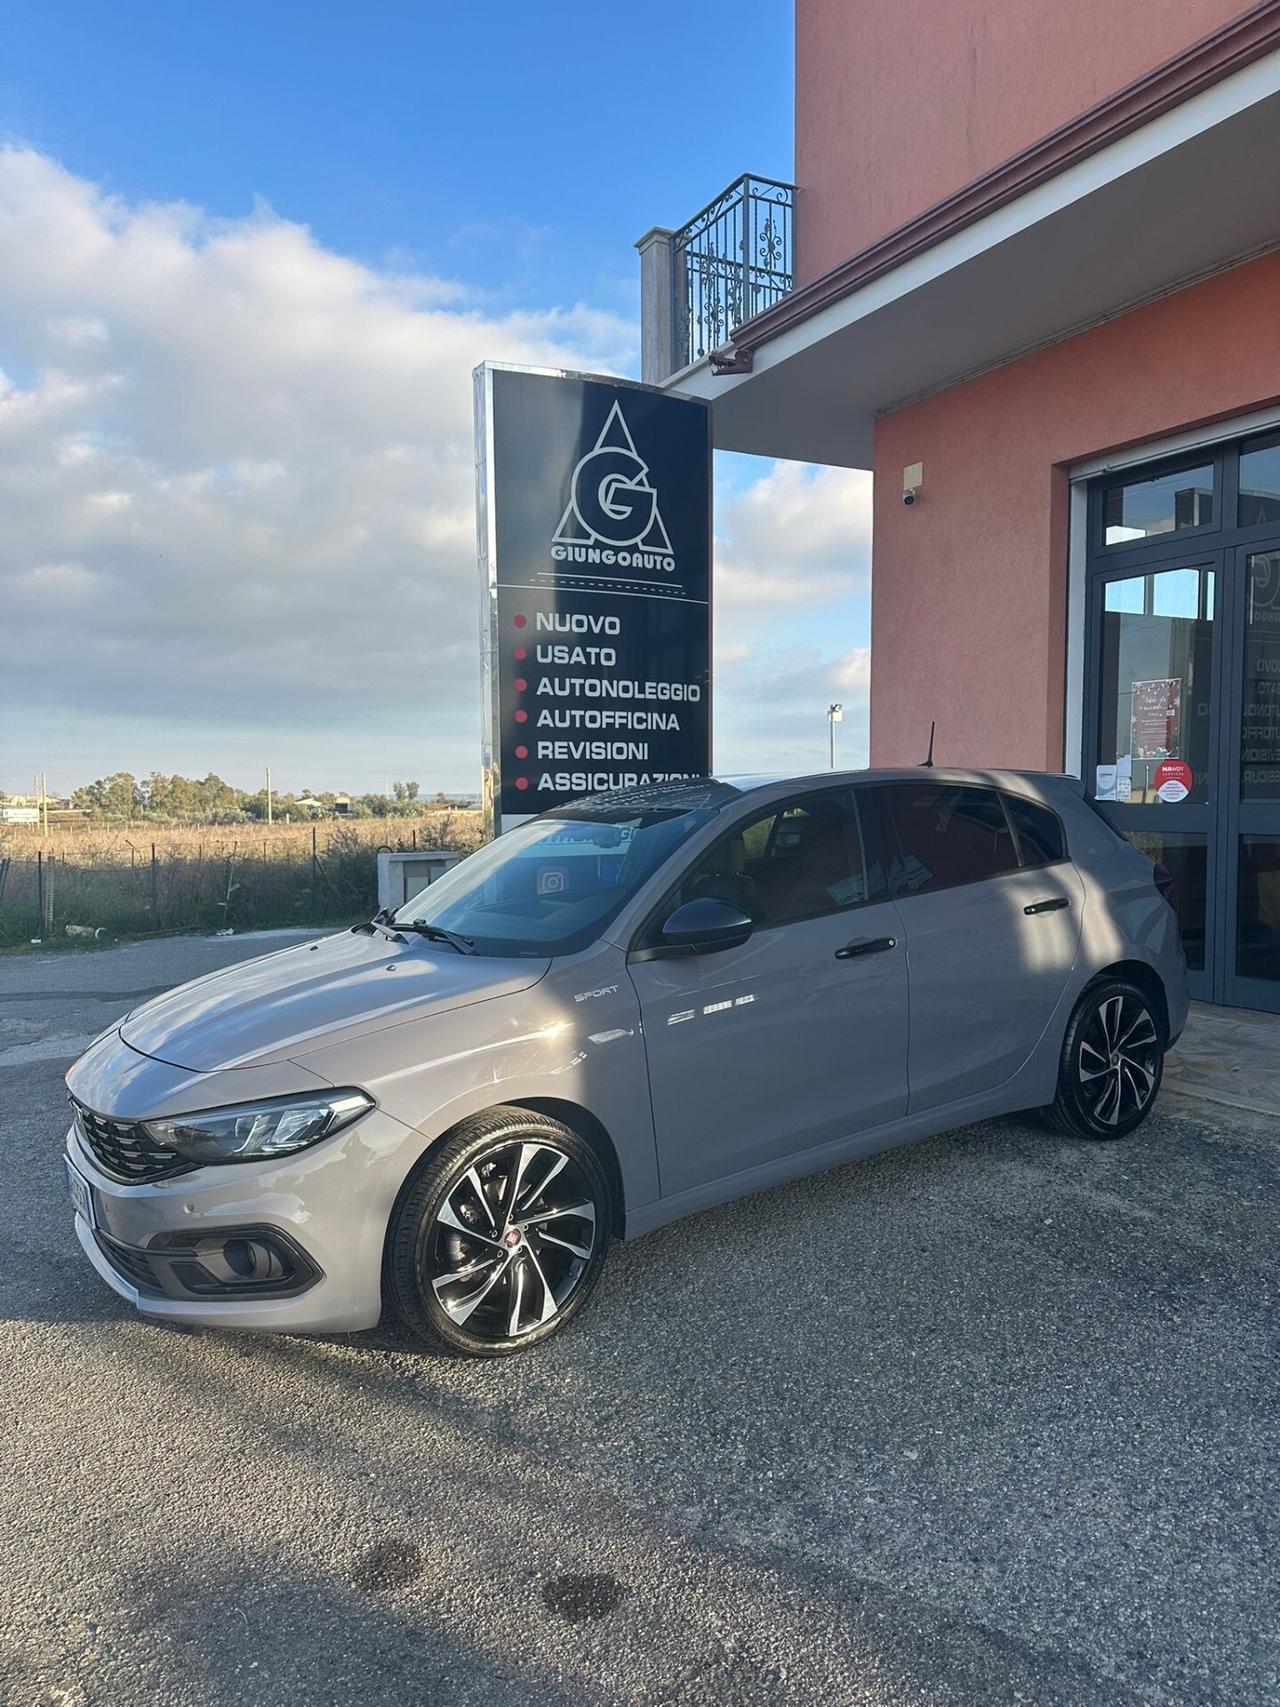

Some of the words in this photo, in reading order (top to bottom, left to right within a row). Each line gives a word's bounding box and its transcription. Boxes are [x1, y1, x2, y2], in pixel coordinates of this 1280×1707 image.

[550, 545, 676, 572] GIUNGOAUTO
[536, 612, 621, 635] NUOVO
[536, 645, 616, 667] USATO
[536, 677, 701, 702] AUTONOLEGGIO
[536, 709, 681, 731] AUTOFFICINA
[537, 741, 649, 760] REVISIONI
[536, 772, 700, 792] ASSICURAZ
[573, 984, 619, 1003] SPORT
